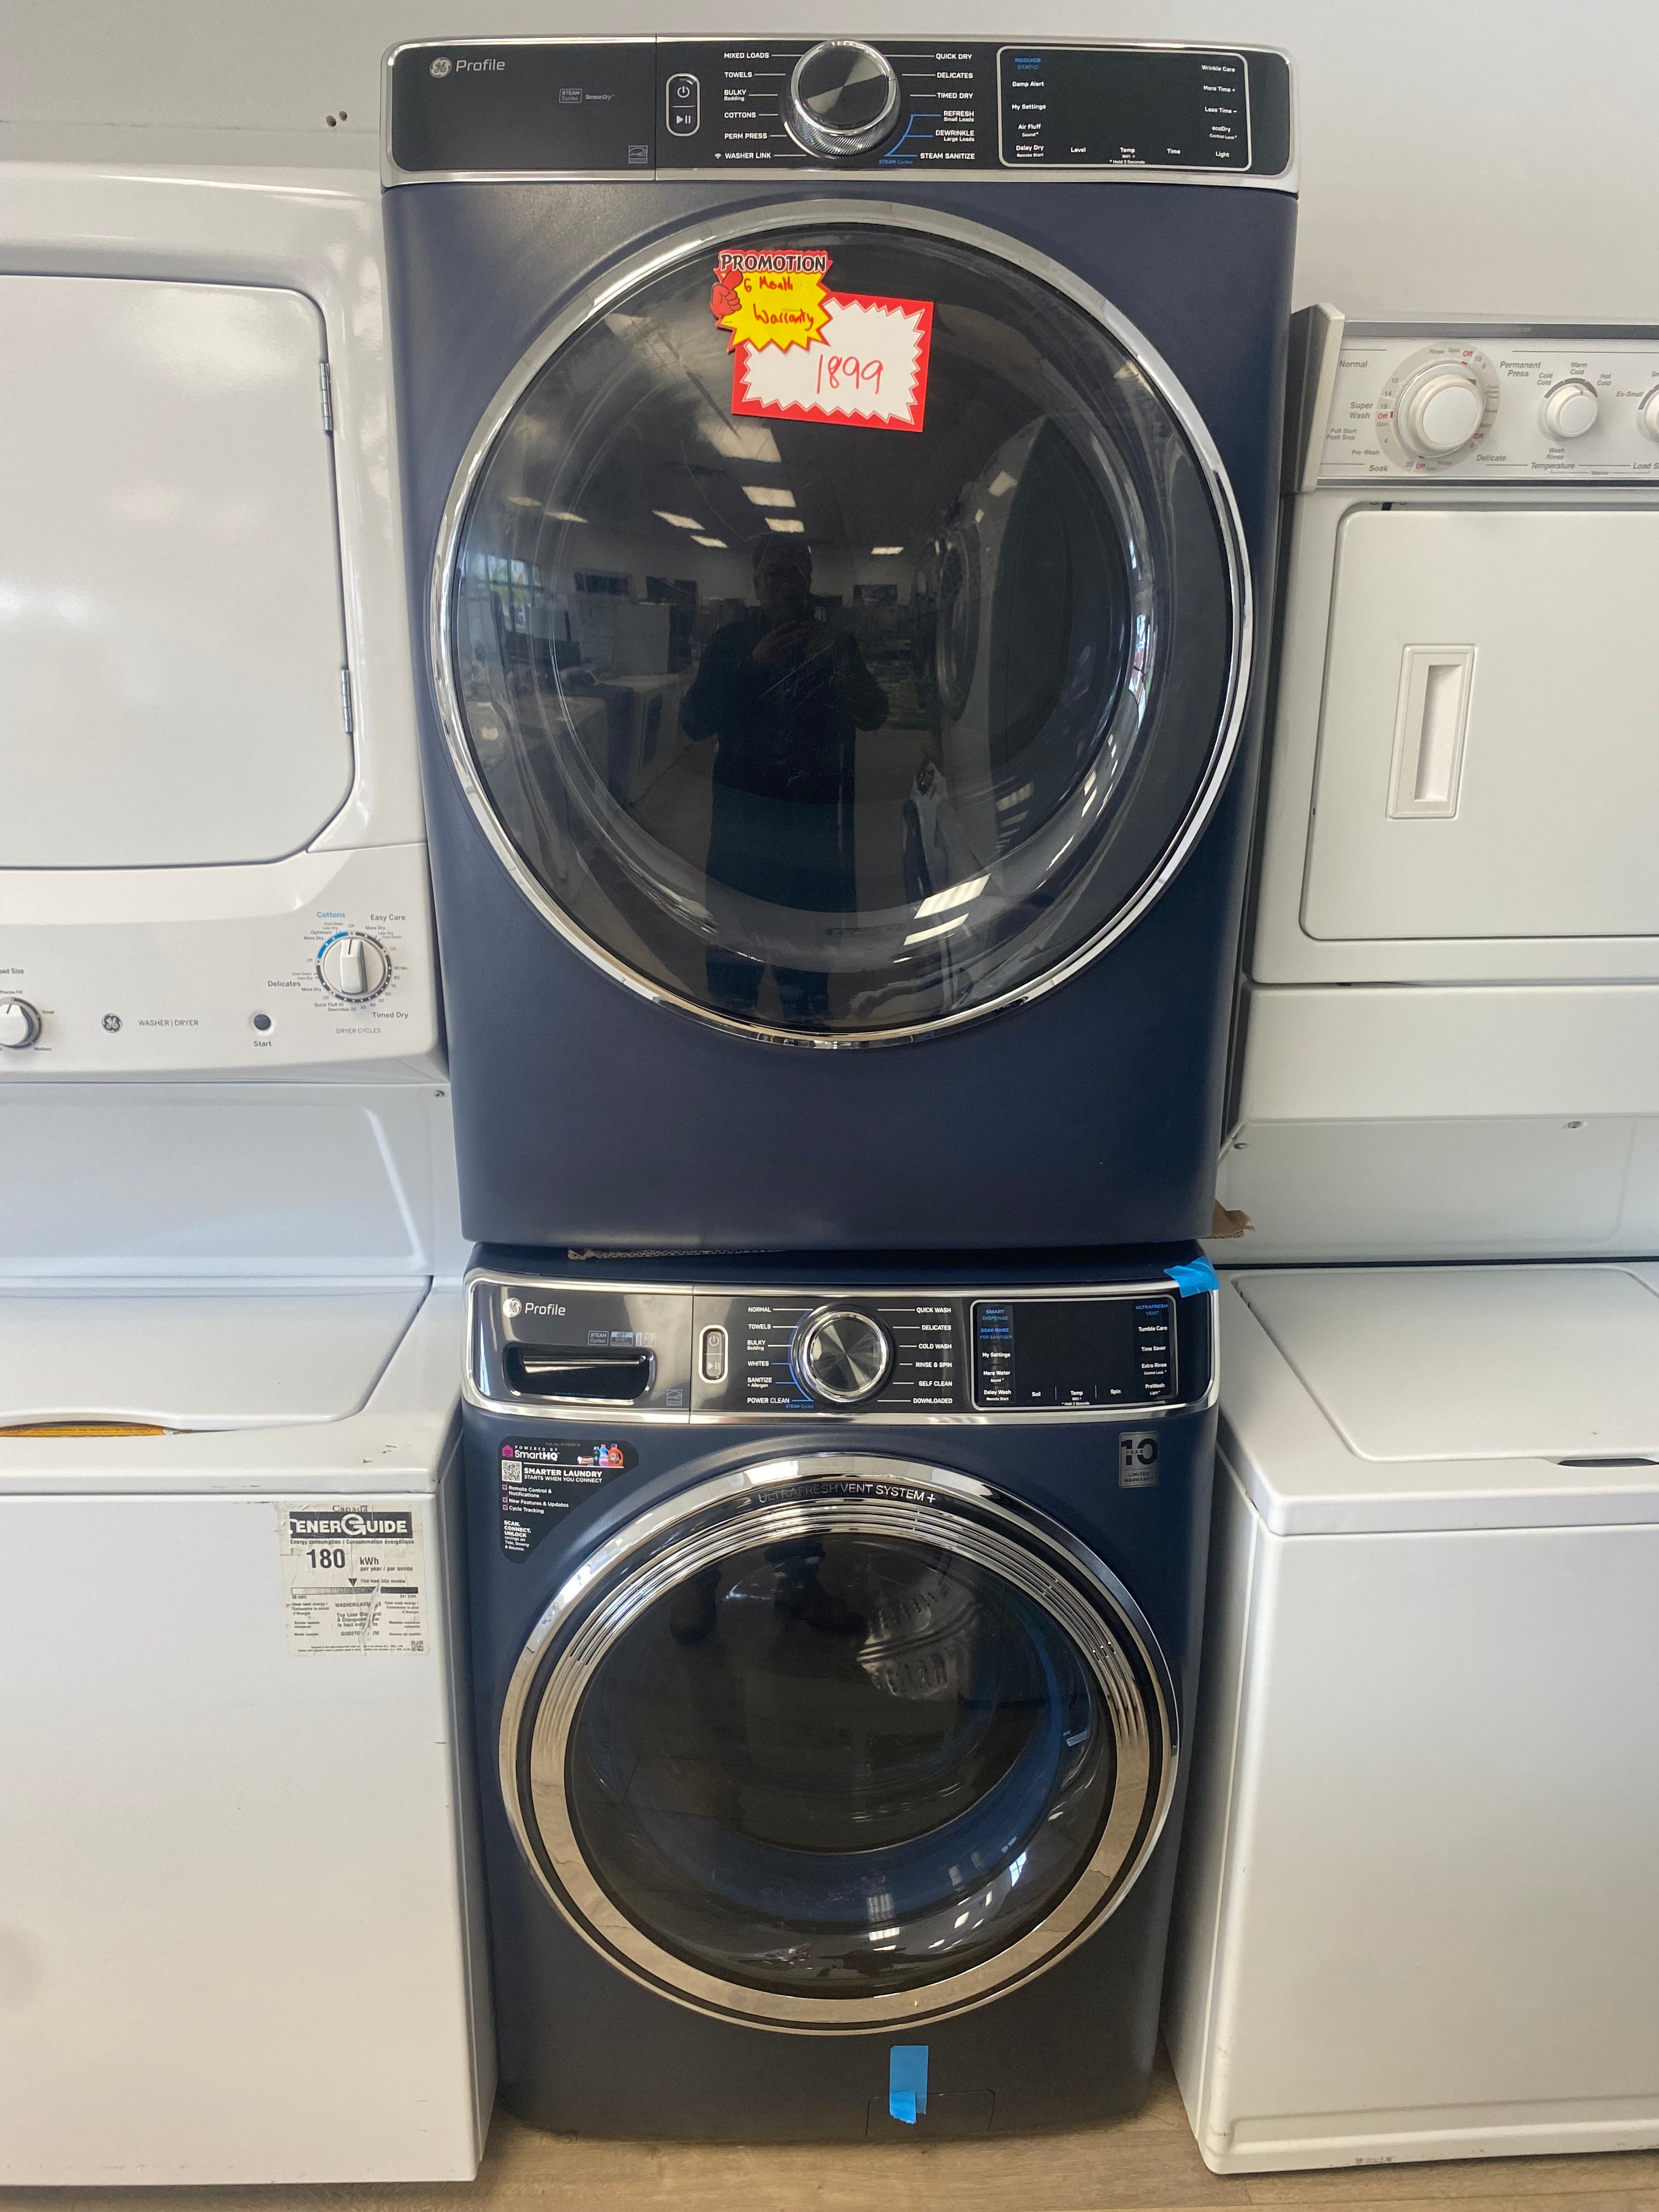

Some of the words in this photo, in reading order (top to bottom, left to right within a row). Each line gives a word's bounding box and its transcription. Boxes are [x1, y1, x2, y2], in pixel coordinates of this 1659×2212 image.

[456, 59, 505, 72] Profile
[720, 255, 827, 273] PROMOTION
[760, 277, 793, 291] Month
[754, 303, 814, 331] Warranty
[817, 354, 883, 394] 1899
[525, 1303, 566, 1316] Profile
[515, 1450, 558, 1461] SmartHQ
[1121, 1438, 1158, 1465] 10
[524, 1468, 561, 1476] SMARTER
[758, 1482, 837, 1503] ULTRAFRESH
[840, 1484, 873, 1493] VENT
[876, 1485, 924, 1501] SYSTEM
[307, 1549, 345, 1568] 180
